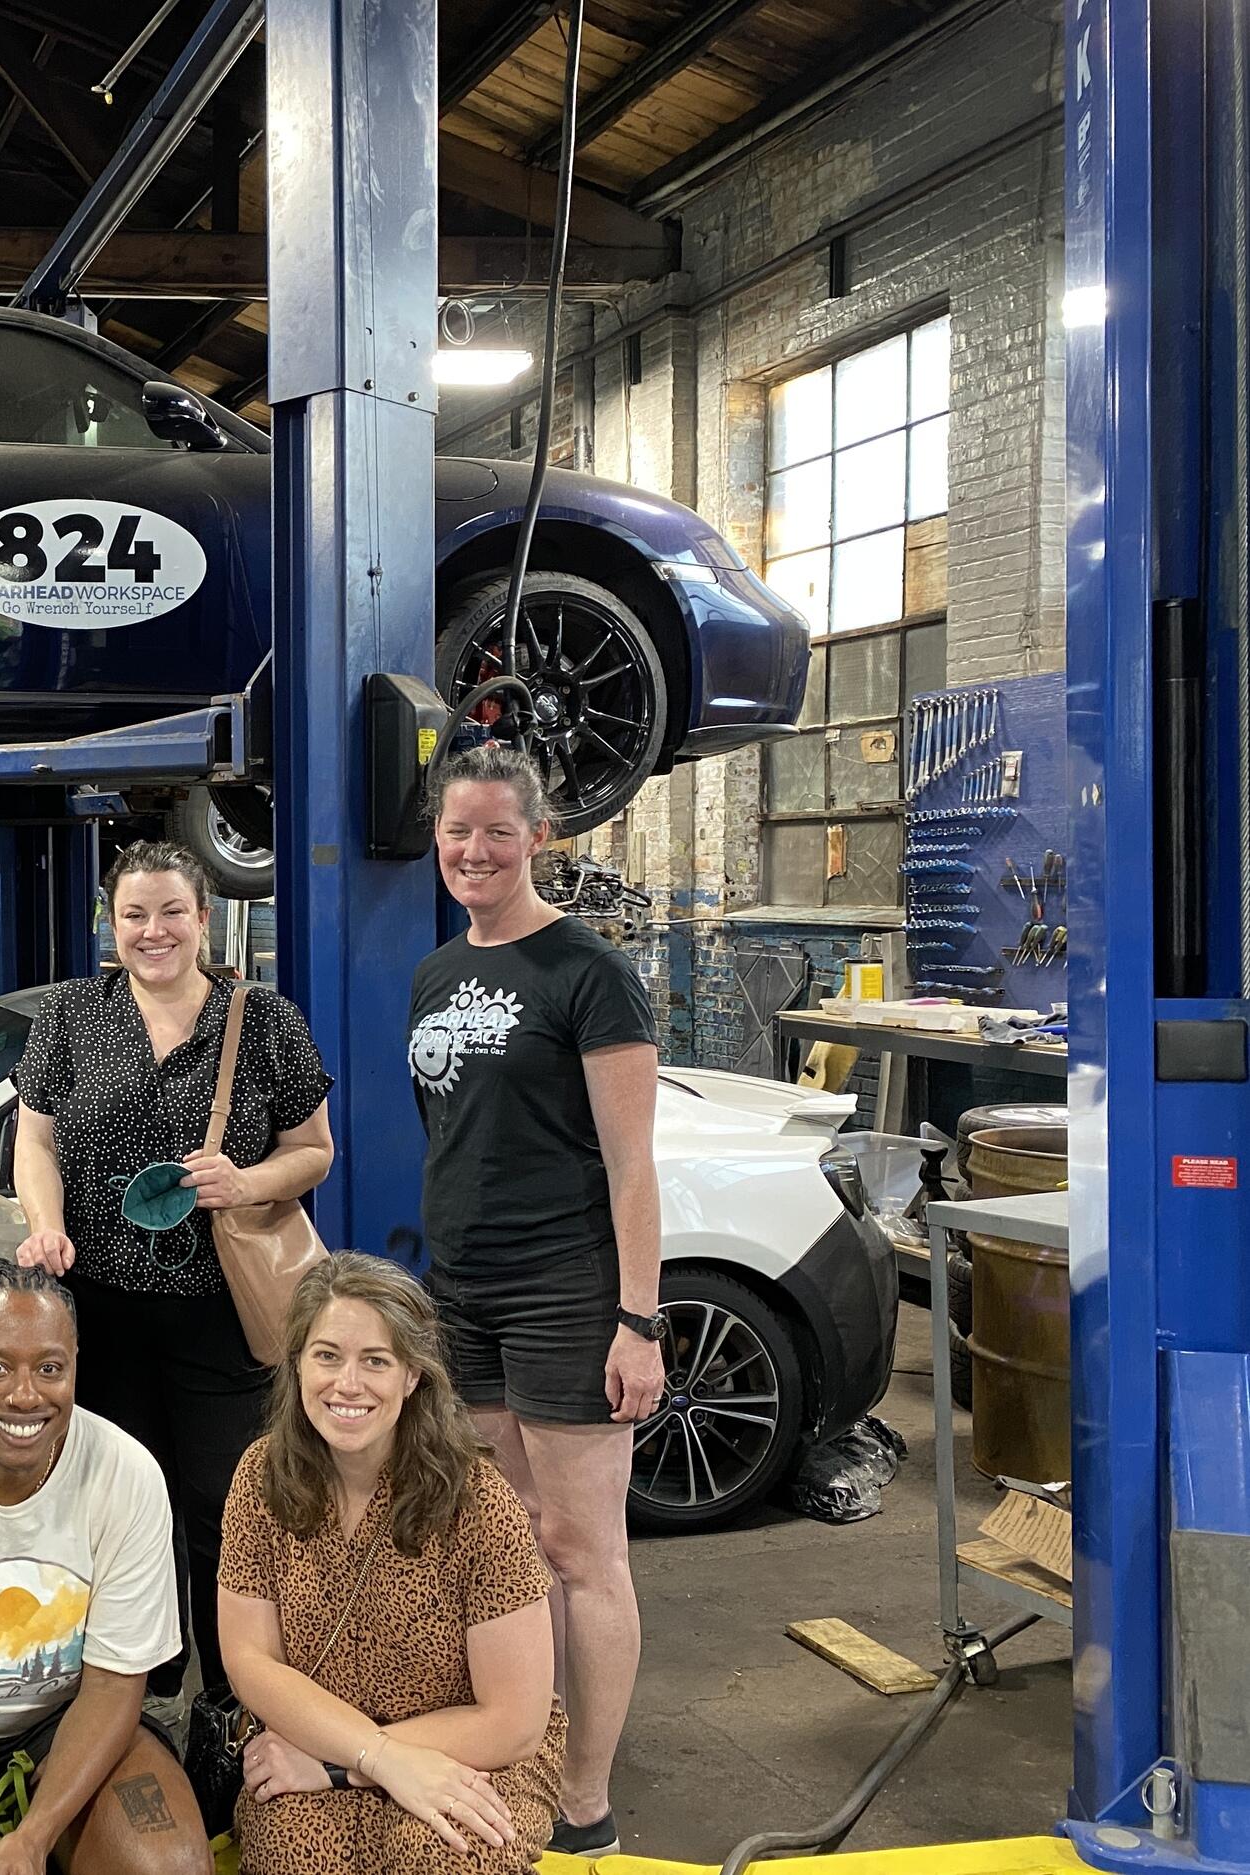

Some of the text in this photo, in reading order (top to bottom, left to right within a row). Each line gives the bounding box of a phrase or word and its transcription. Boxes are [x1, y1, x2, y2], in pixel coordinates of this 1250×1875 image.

[75, 586, 186, 601] WORKSPACE
[2, 600, 21, 614] Go
[26, 601, 80, 614] Wrench
[418, 1010, 513, 1030] GEARHEAD
[412, 1028, 510, 1046] WORKSPACE
[490, 1047, 506, 1056] Car
